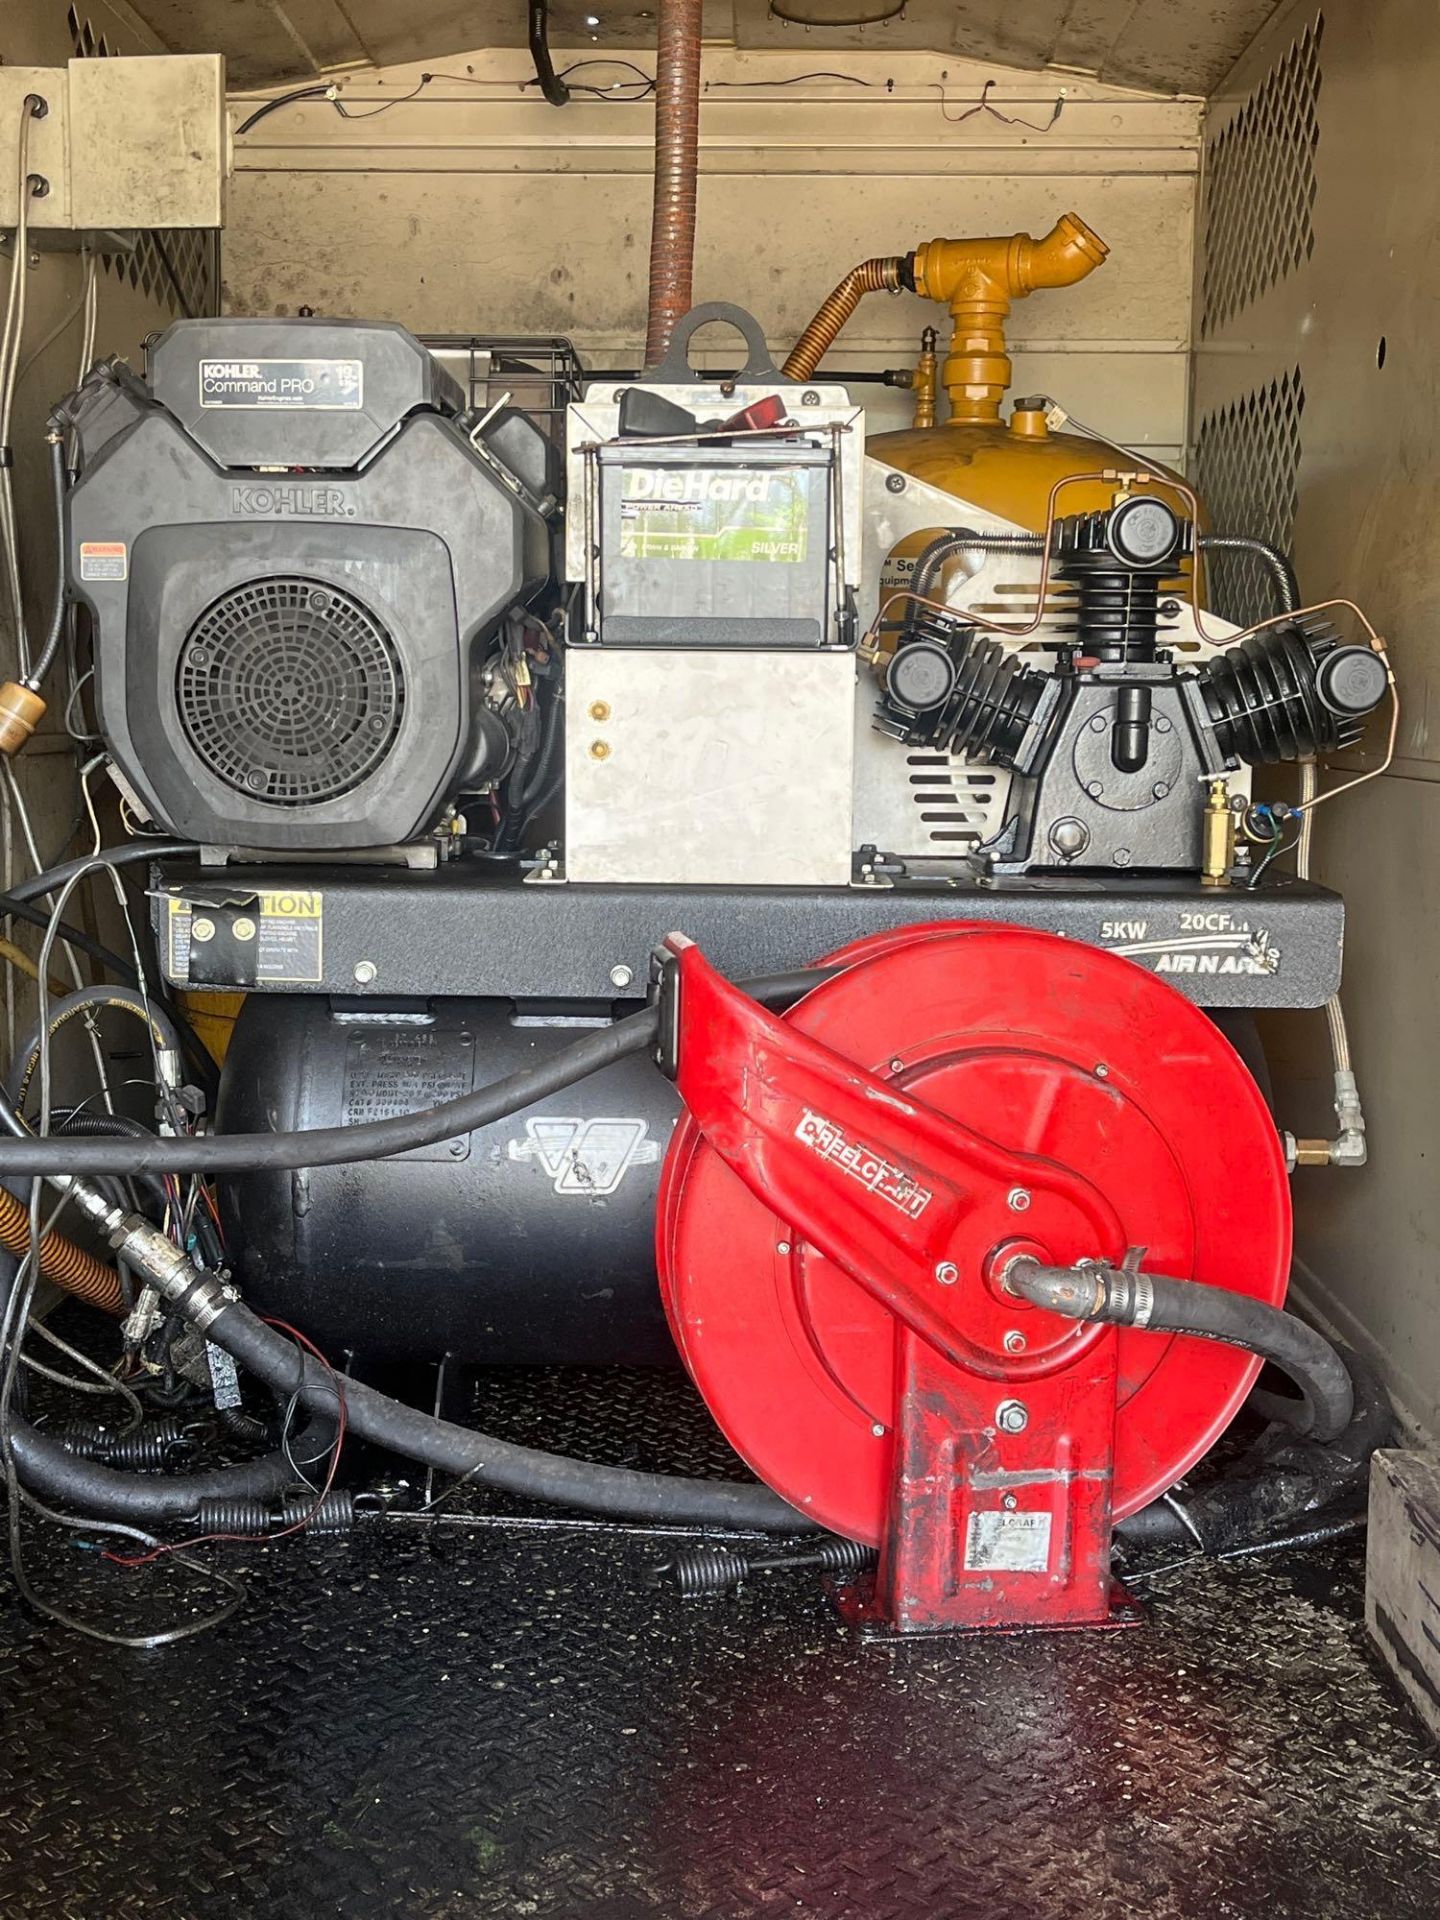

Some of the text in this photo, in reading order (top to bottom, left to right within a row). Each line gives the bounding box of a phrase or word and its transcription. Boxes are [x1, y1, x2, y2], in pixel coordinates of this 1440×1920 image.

[203, 378, 314, 394] Command PRO
[629, 468, 770, 501] DieHard
[751, 542, 799, 555] SILVER
[1100, 922, 1147, 939] 5KW
[1154, 954, 1197, 974] AIR
[1197, 956, 1219, 974] N
